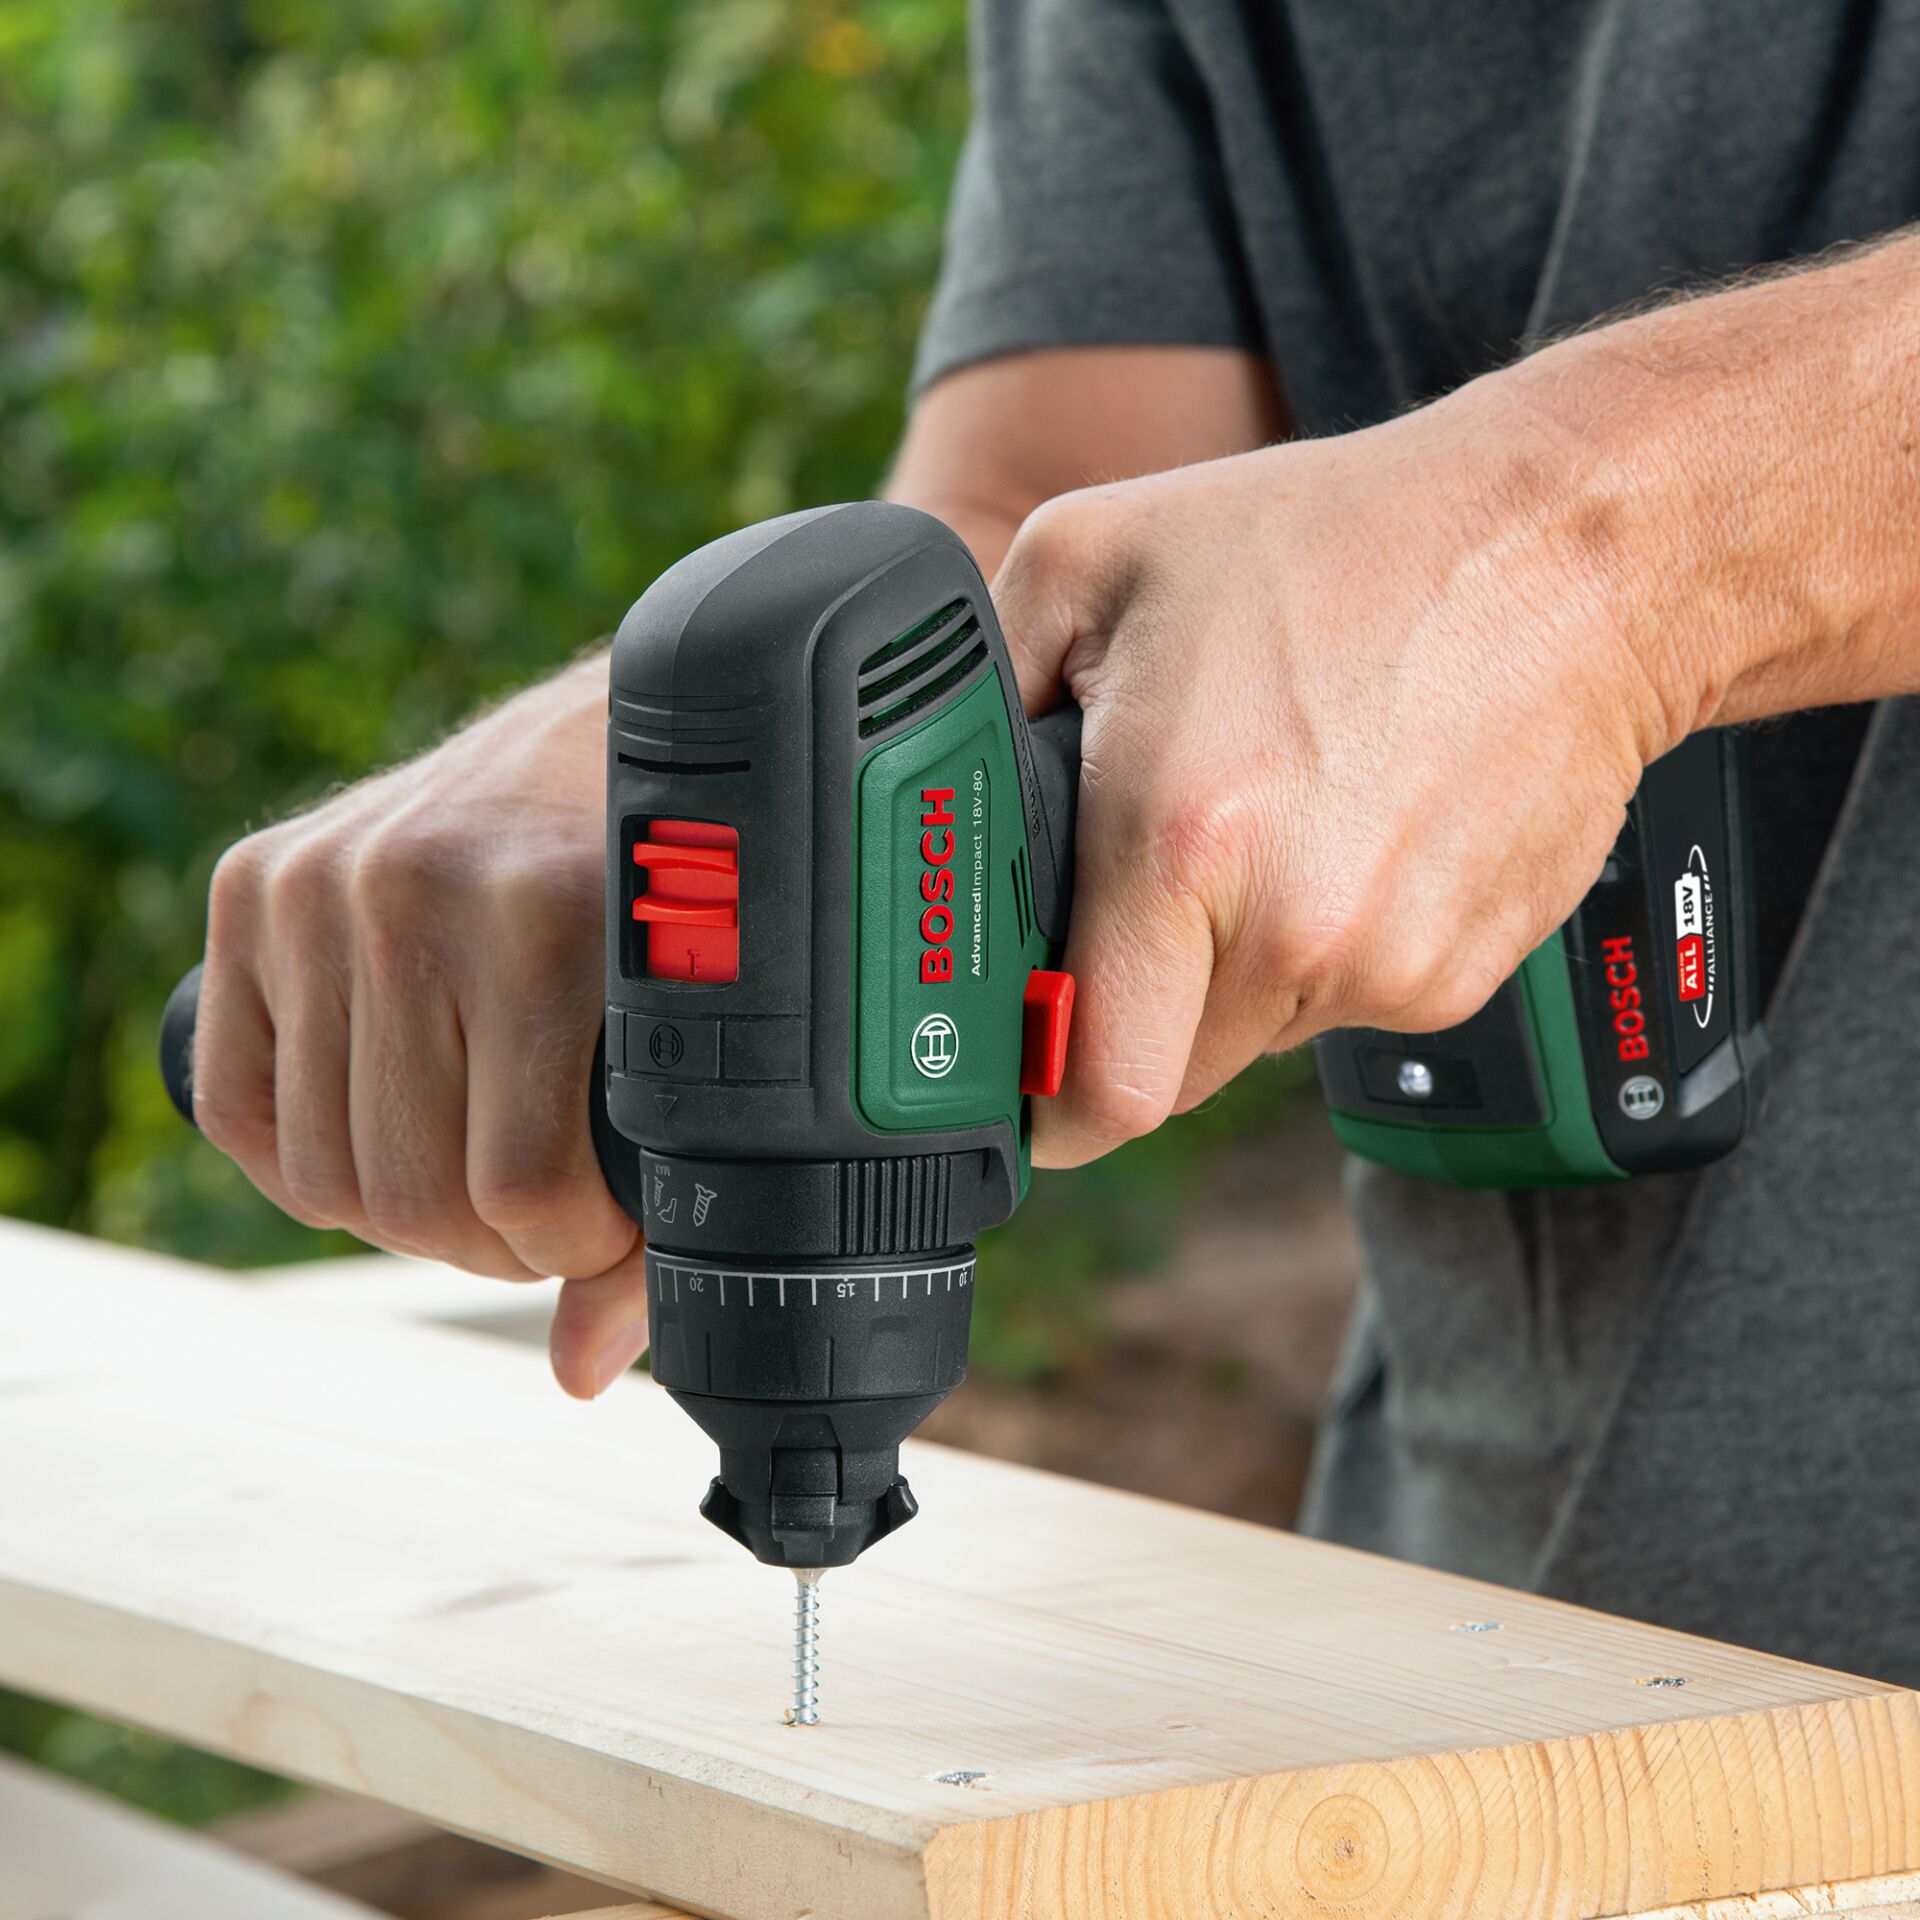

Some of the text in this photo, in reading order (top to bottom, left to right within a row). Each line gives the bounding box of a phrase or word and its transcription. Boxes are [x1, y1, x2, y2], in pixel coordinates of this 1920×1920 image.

[921, 789, 955, 983] BOSCH
[971, 770, 984, 977] AdvancedImpact 18V-80
[1682, 886, 1698, 990] ALL 18V
[1704, 893, 1716, 975] ALLIANCE
[1601, 936, 1649, 1061] BOSCH
[655, 1164, 671, 1177] MAX
[689, 1277, 704, 1292] 20
[836, 1282, 855, 1298] 15
[959, 1271, 967, 1288] 10
